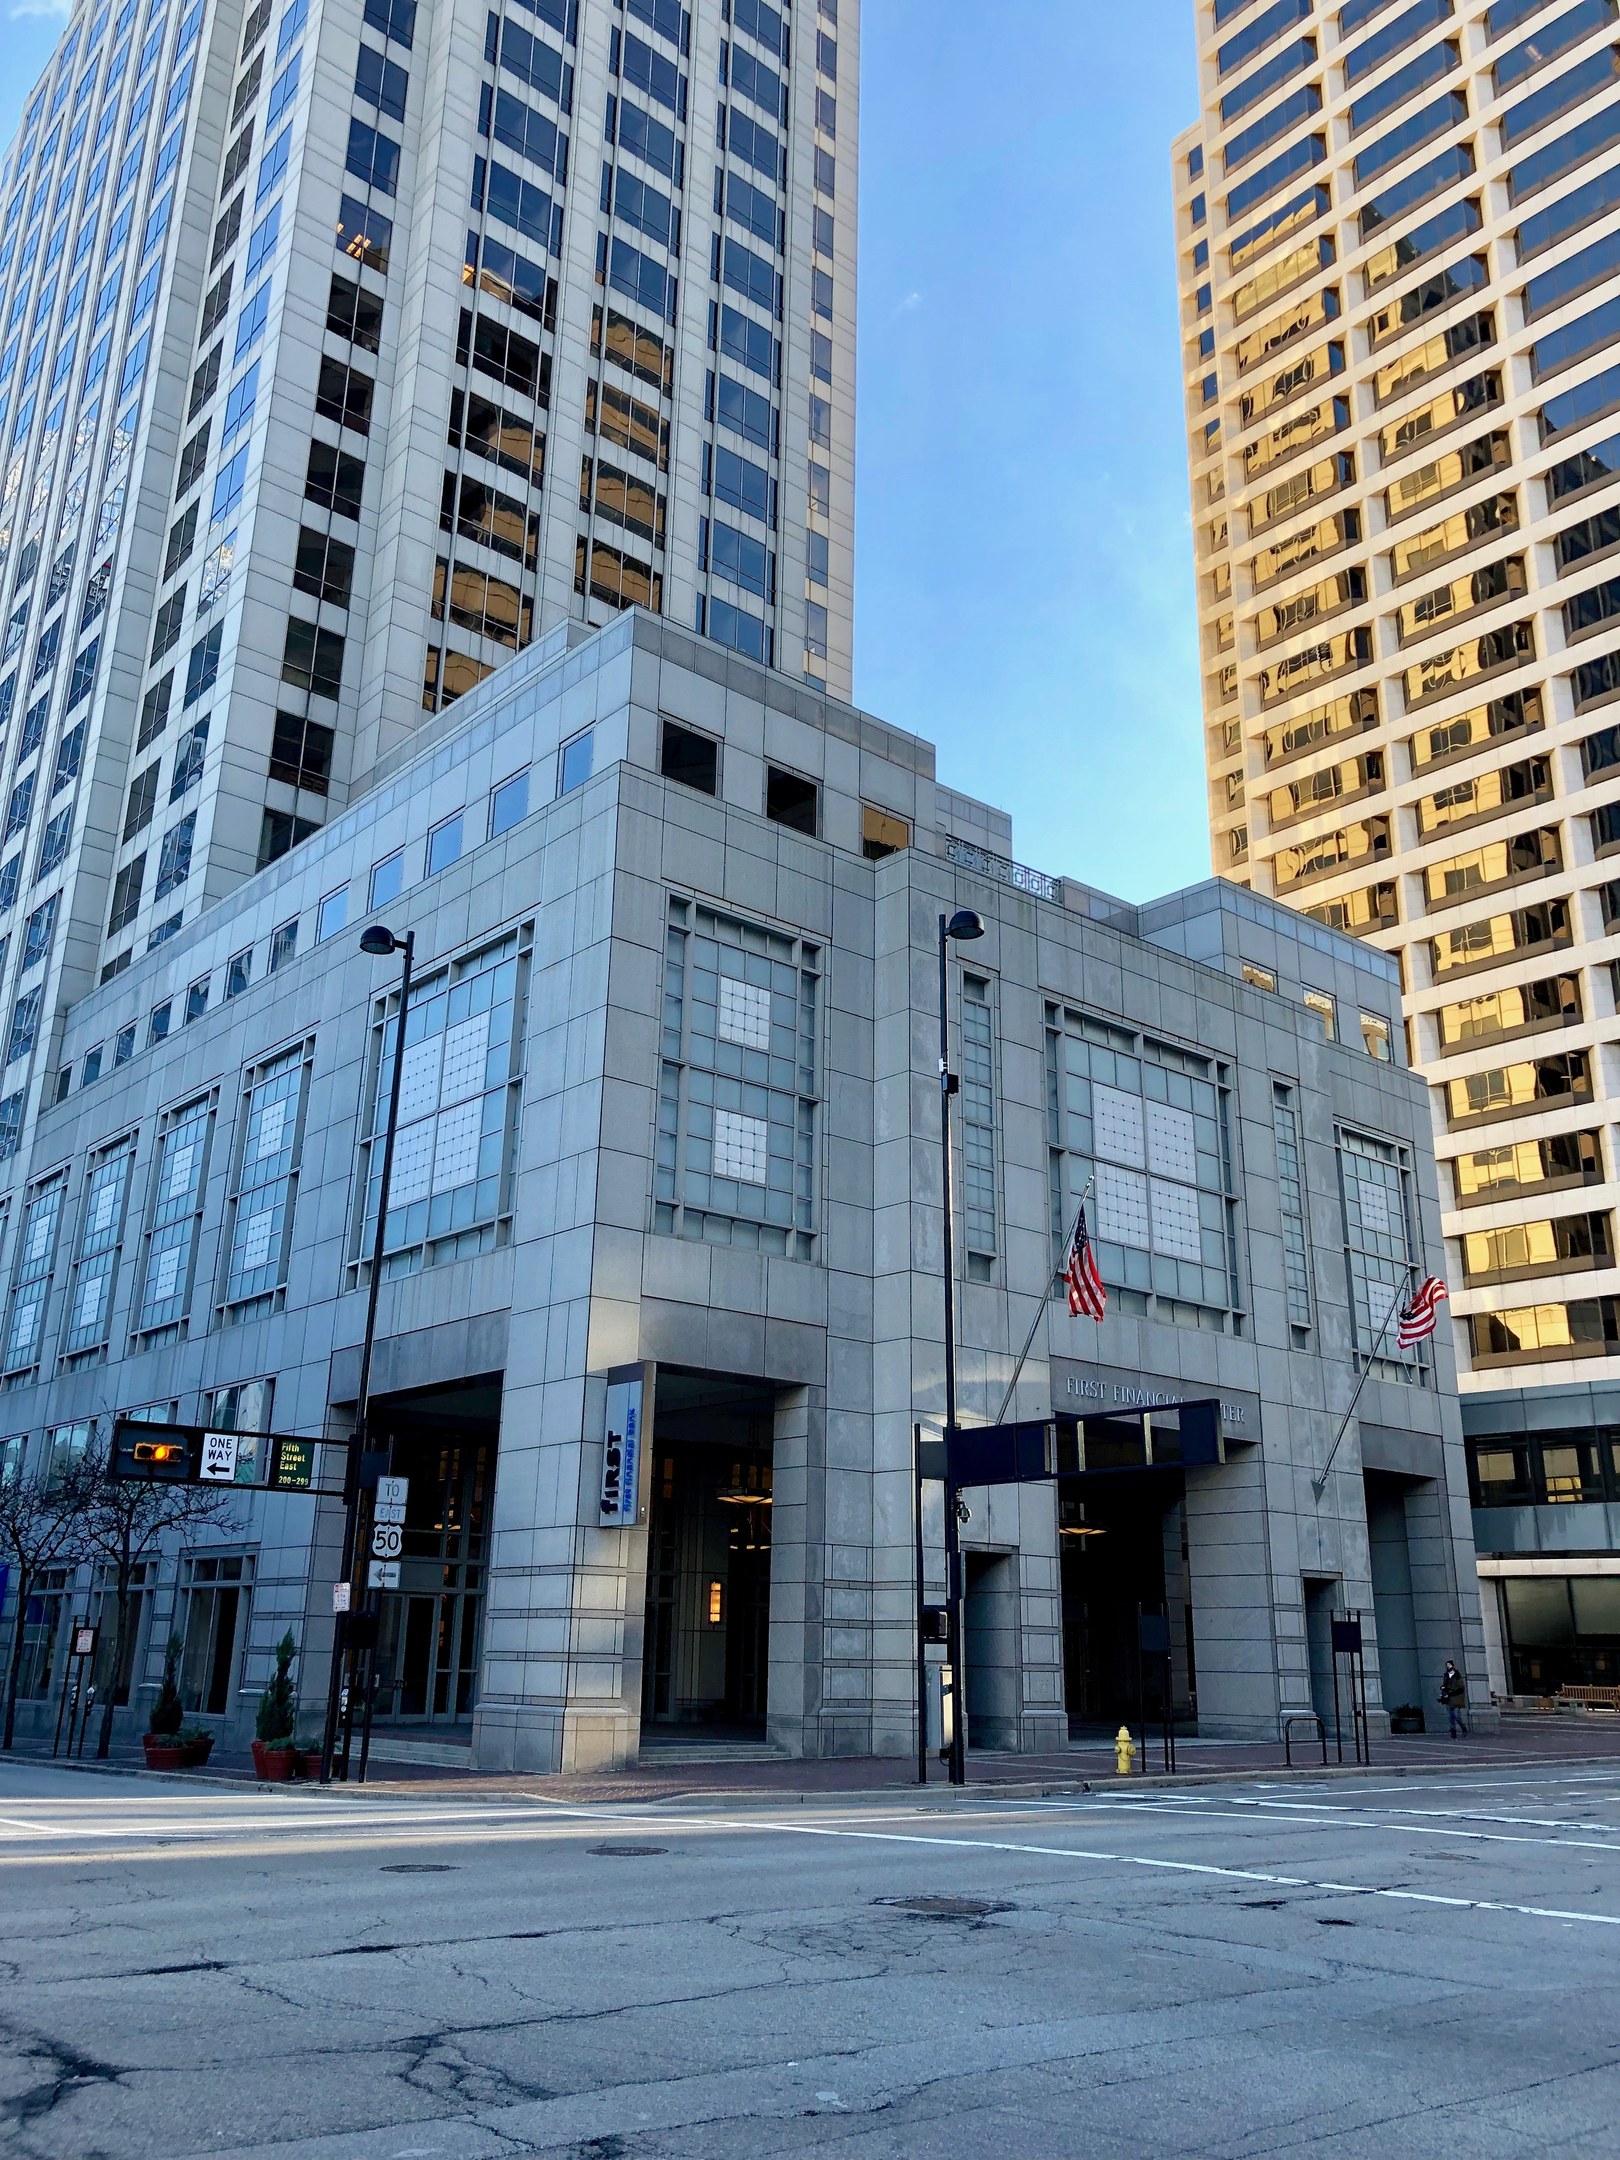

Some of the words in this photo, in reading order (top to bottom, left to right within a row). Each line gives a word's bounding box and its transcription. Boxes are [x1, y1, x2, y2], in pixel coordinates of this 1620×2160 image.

[1066, 1377, 1107, 1399] FIRST
[1220, 1403, 1246, 1424] TER
[210, 1437, 232, 1449] ONE
[281, 1442, 300, 1453] Fifth
[208, 1449, 232, 1461] WAY
[280, 1452, 306, 1462] Street
[279, 1461, 297, 1471] East
[385, 1483, 400, 1497] TO
[379, 1508, 401, 1519] EAST
[375, 1530, 399, 1551] 50
